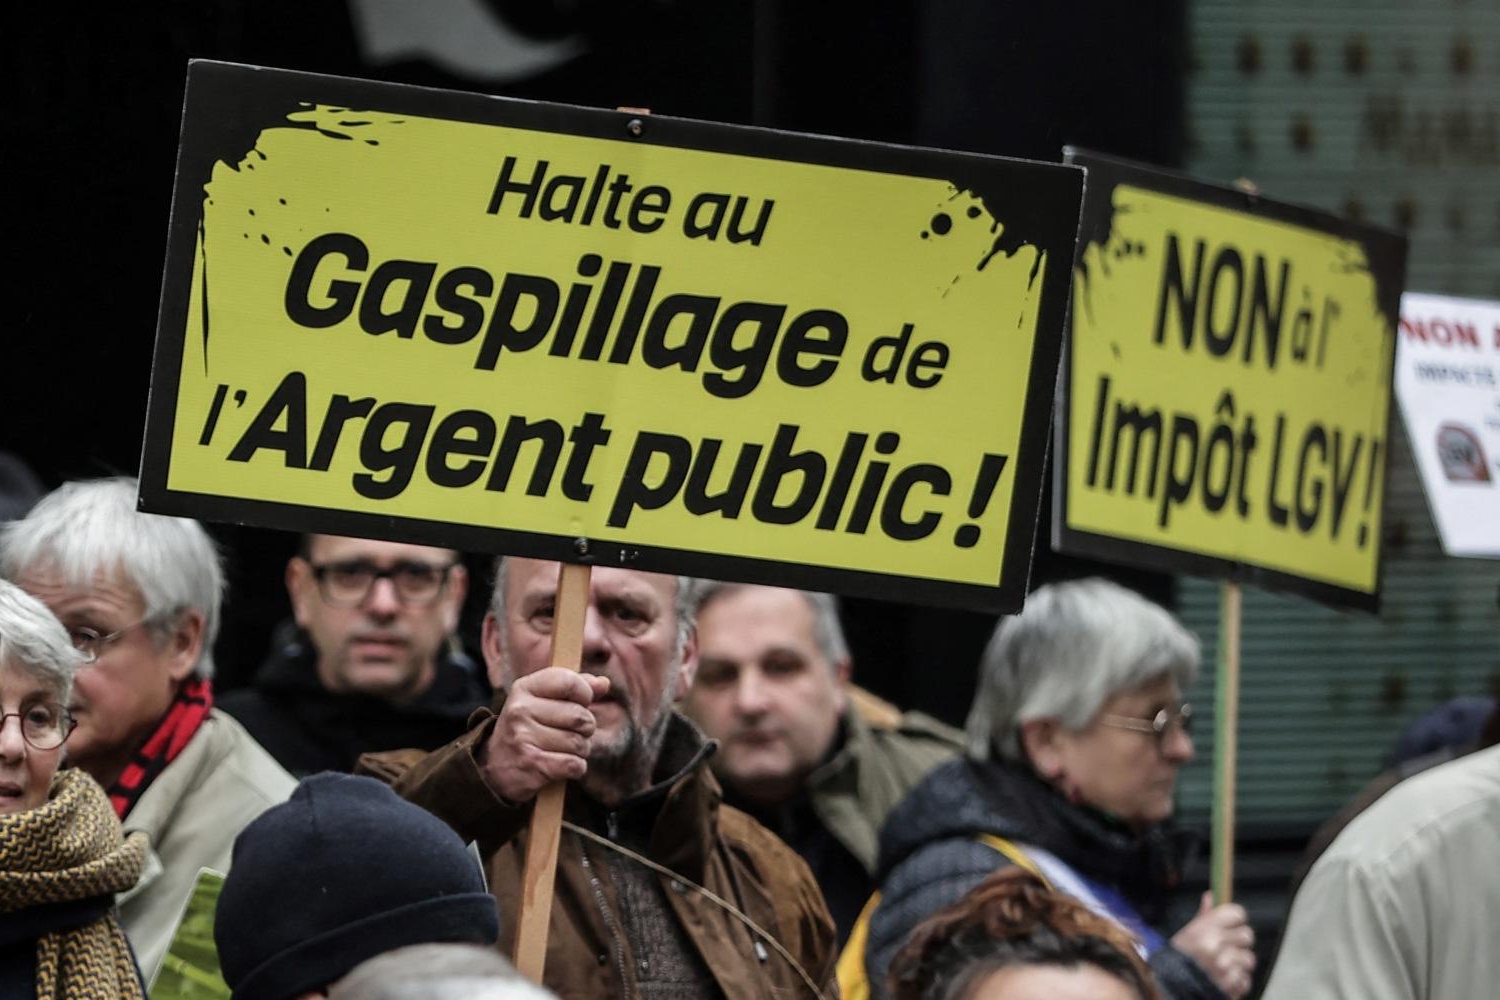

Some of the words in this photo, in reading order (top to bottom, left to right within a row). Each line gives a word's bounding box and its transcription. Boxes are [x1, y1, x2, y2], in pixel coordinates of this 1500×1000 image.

[487, 156, 671, 235] Halte
[682, 192, 774, 247] au
[285, 233, 848, 398] Gaspillage
[862, 324, 950, 388] de
[1154, 232, 1291, 369] NON
[1400, 317, 1479, 347] NON
[199, 372, 612, 502] l'Argent
[1086, 376, 1257, 528] Impôt
